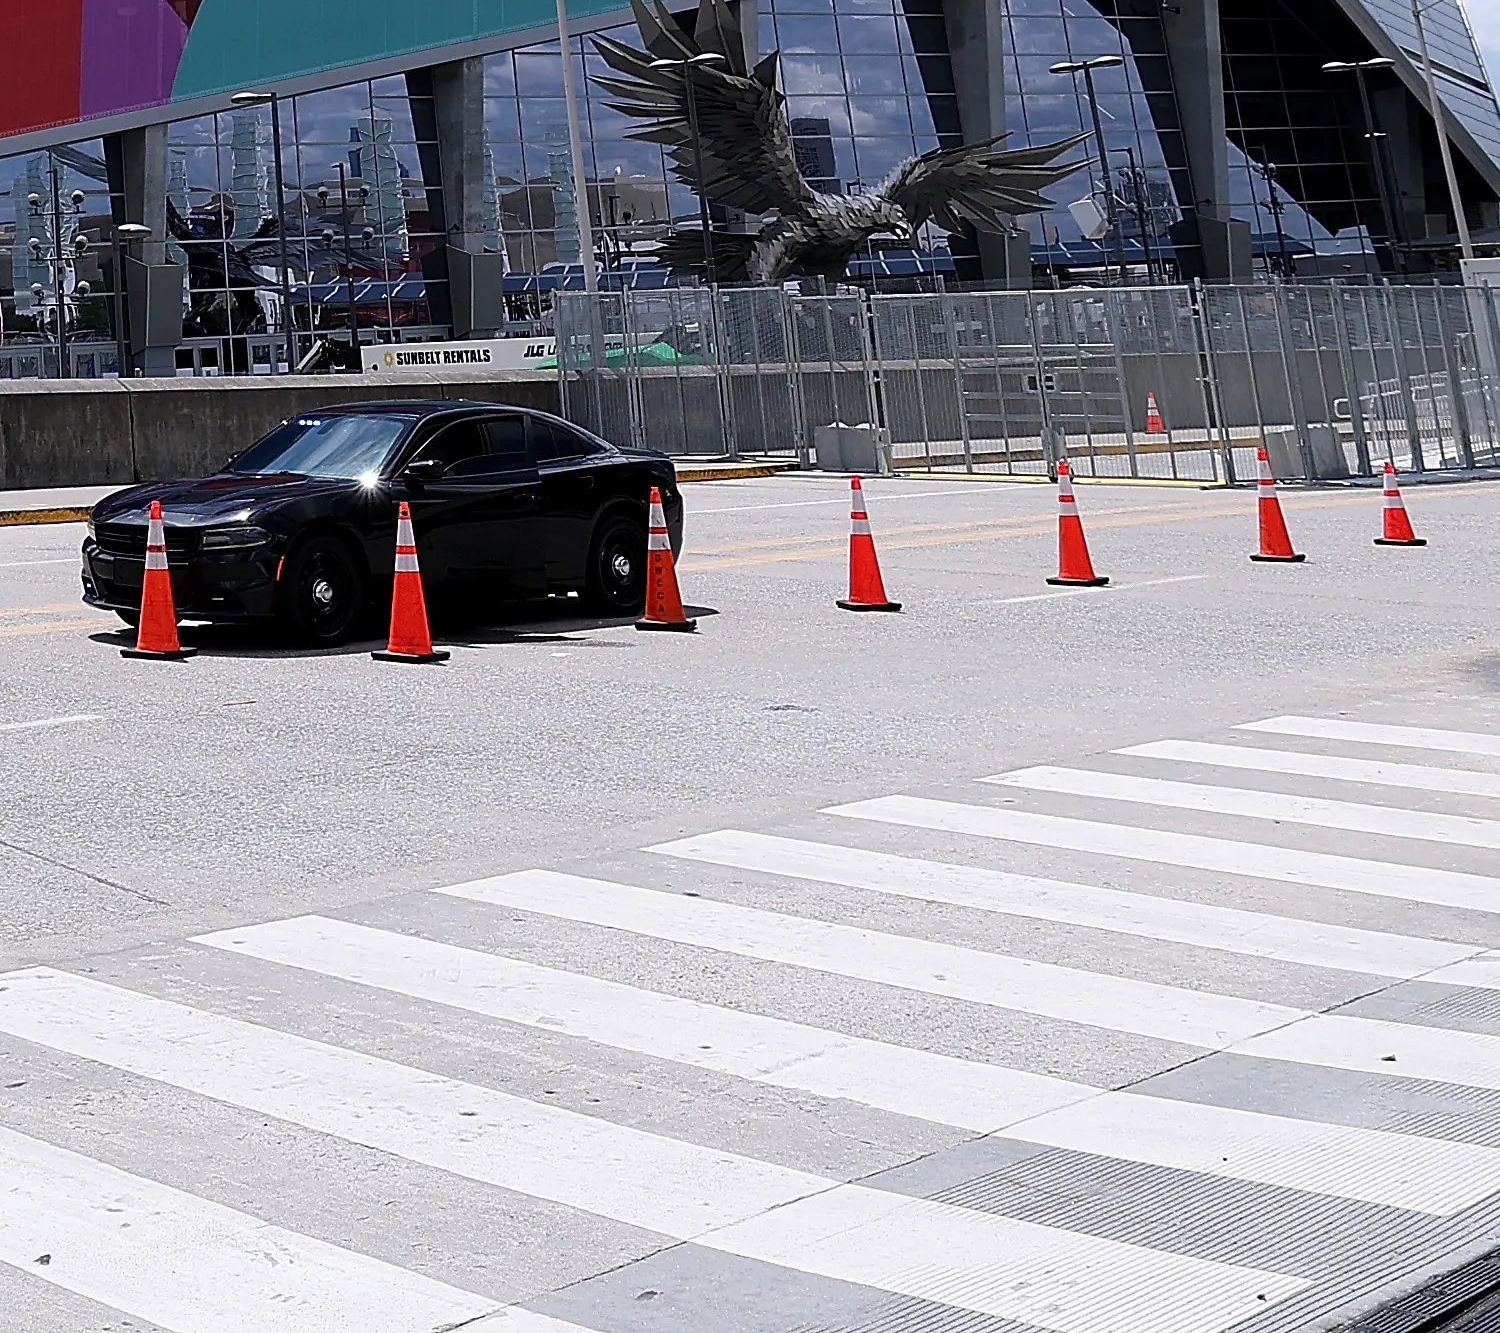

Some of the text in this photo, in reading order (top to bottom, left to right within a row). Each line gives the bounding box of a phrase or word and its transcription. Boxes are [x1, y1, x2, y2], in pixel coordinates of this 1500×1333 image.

[397, 349, 491, 365] SUNBELT RENTALS
[524, 344, 545, 357] JLG
